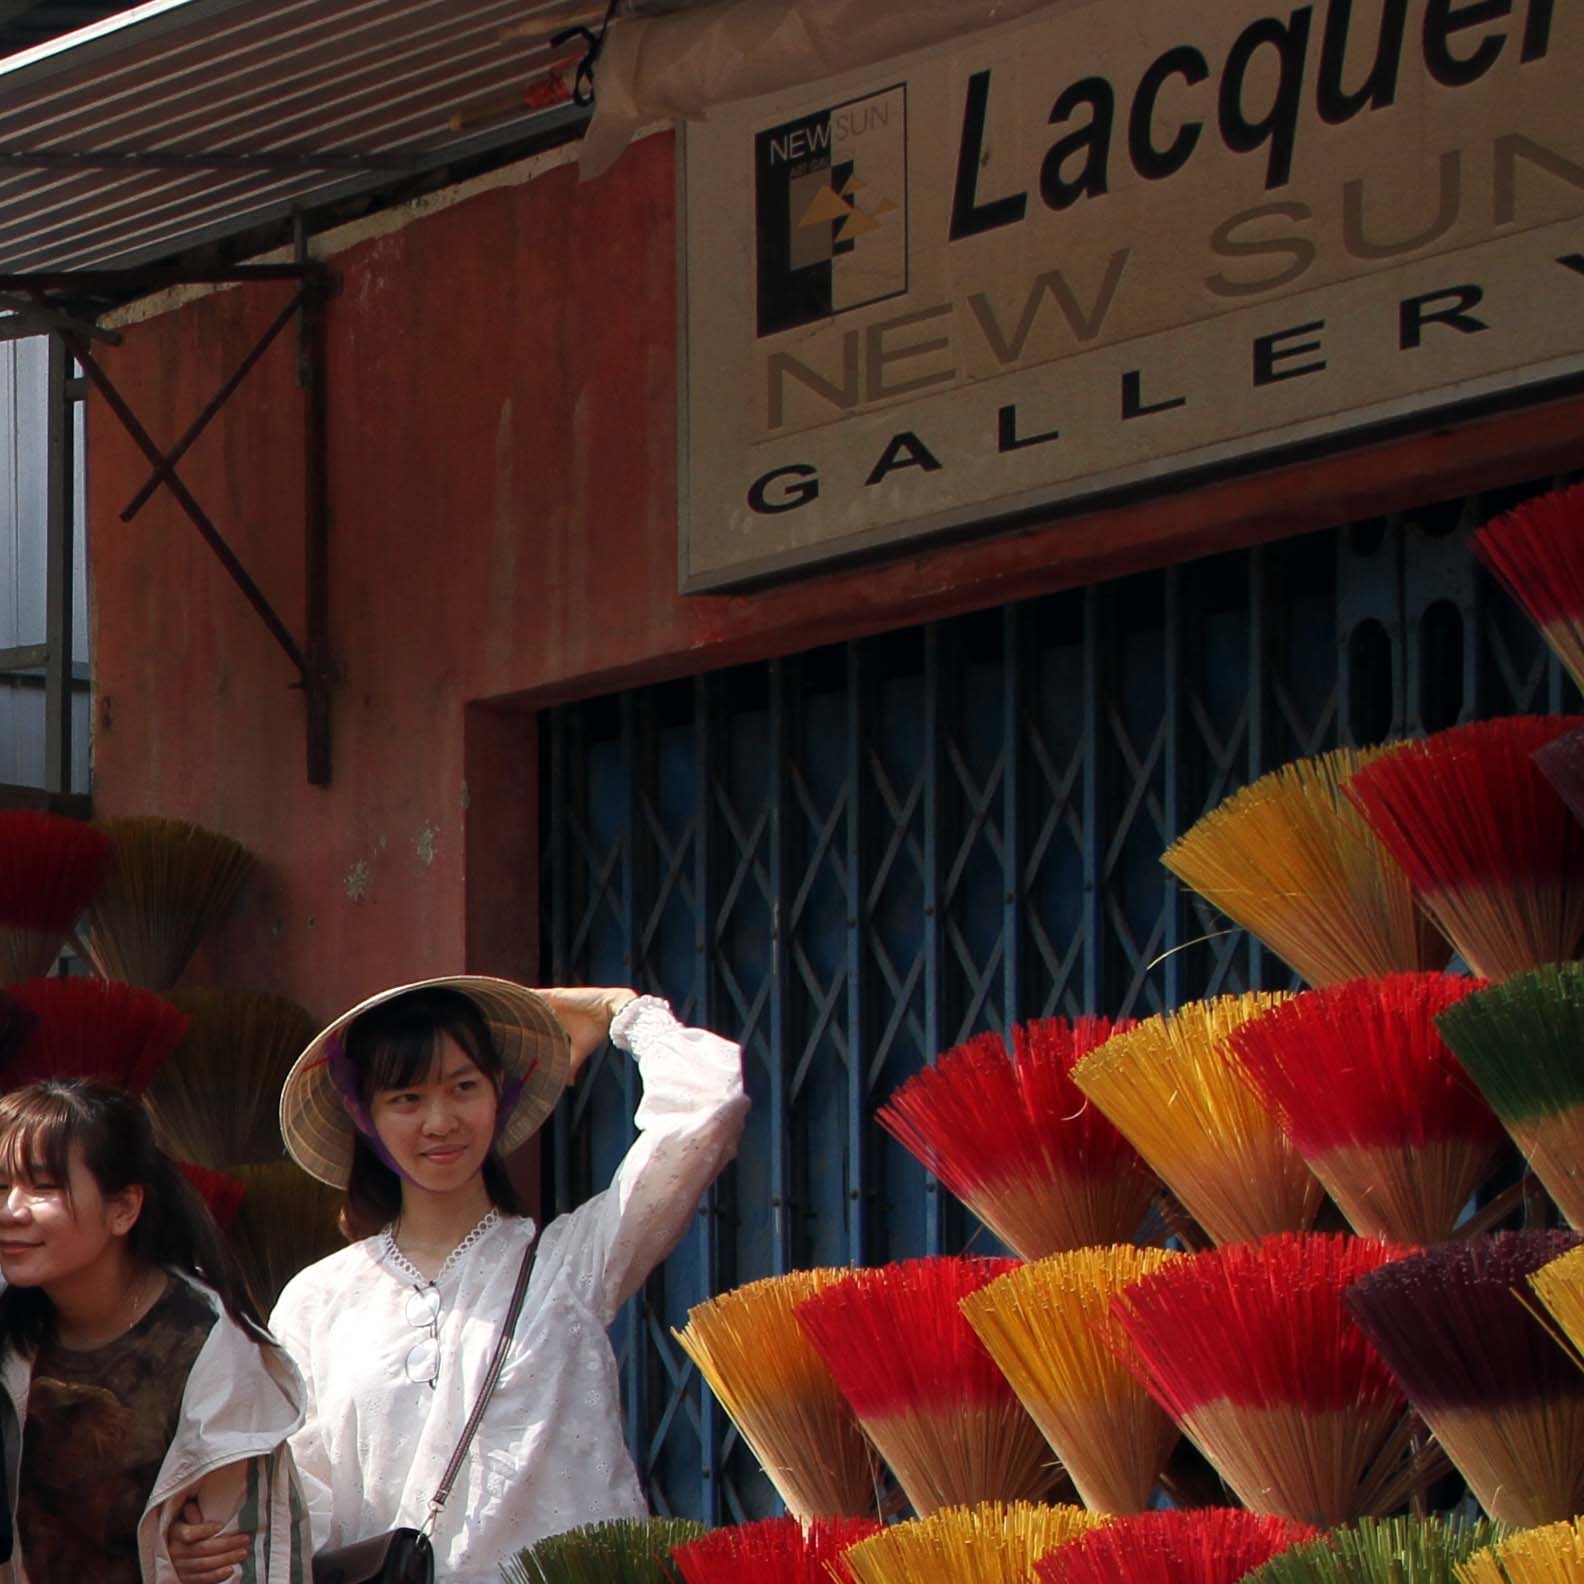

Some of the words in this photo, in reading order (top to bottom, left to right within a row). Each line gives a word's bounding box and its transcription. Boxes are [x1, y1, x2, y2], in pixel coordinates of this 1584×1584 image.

[769, 120, 832, 166] NEW
[835, 102, 888, 141] SUN
[766, 249, 1130, 431] NEW
